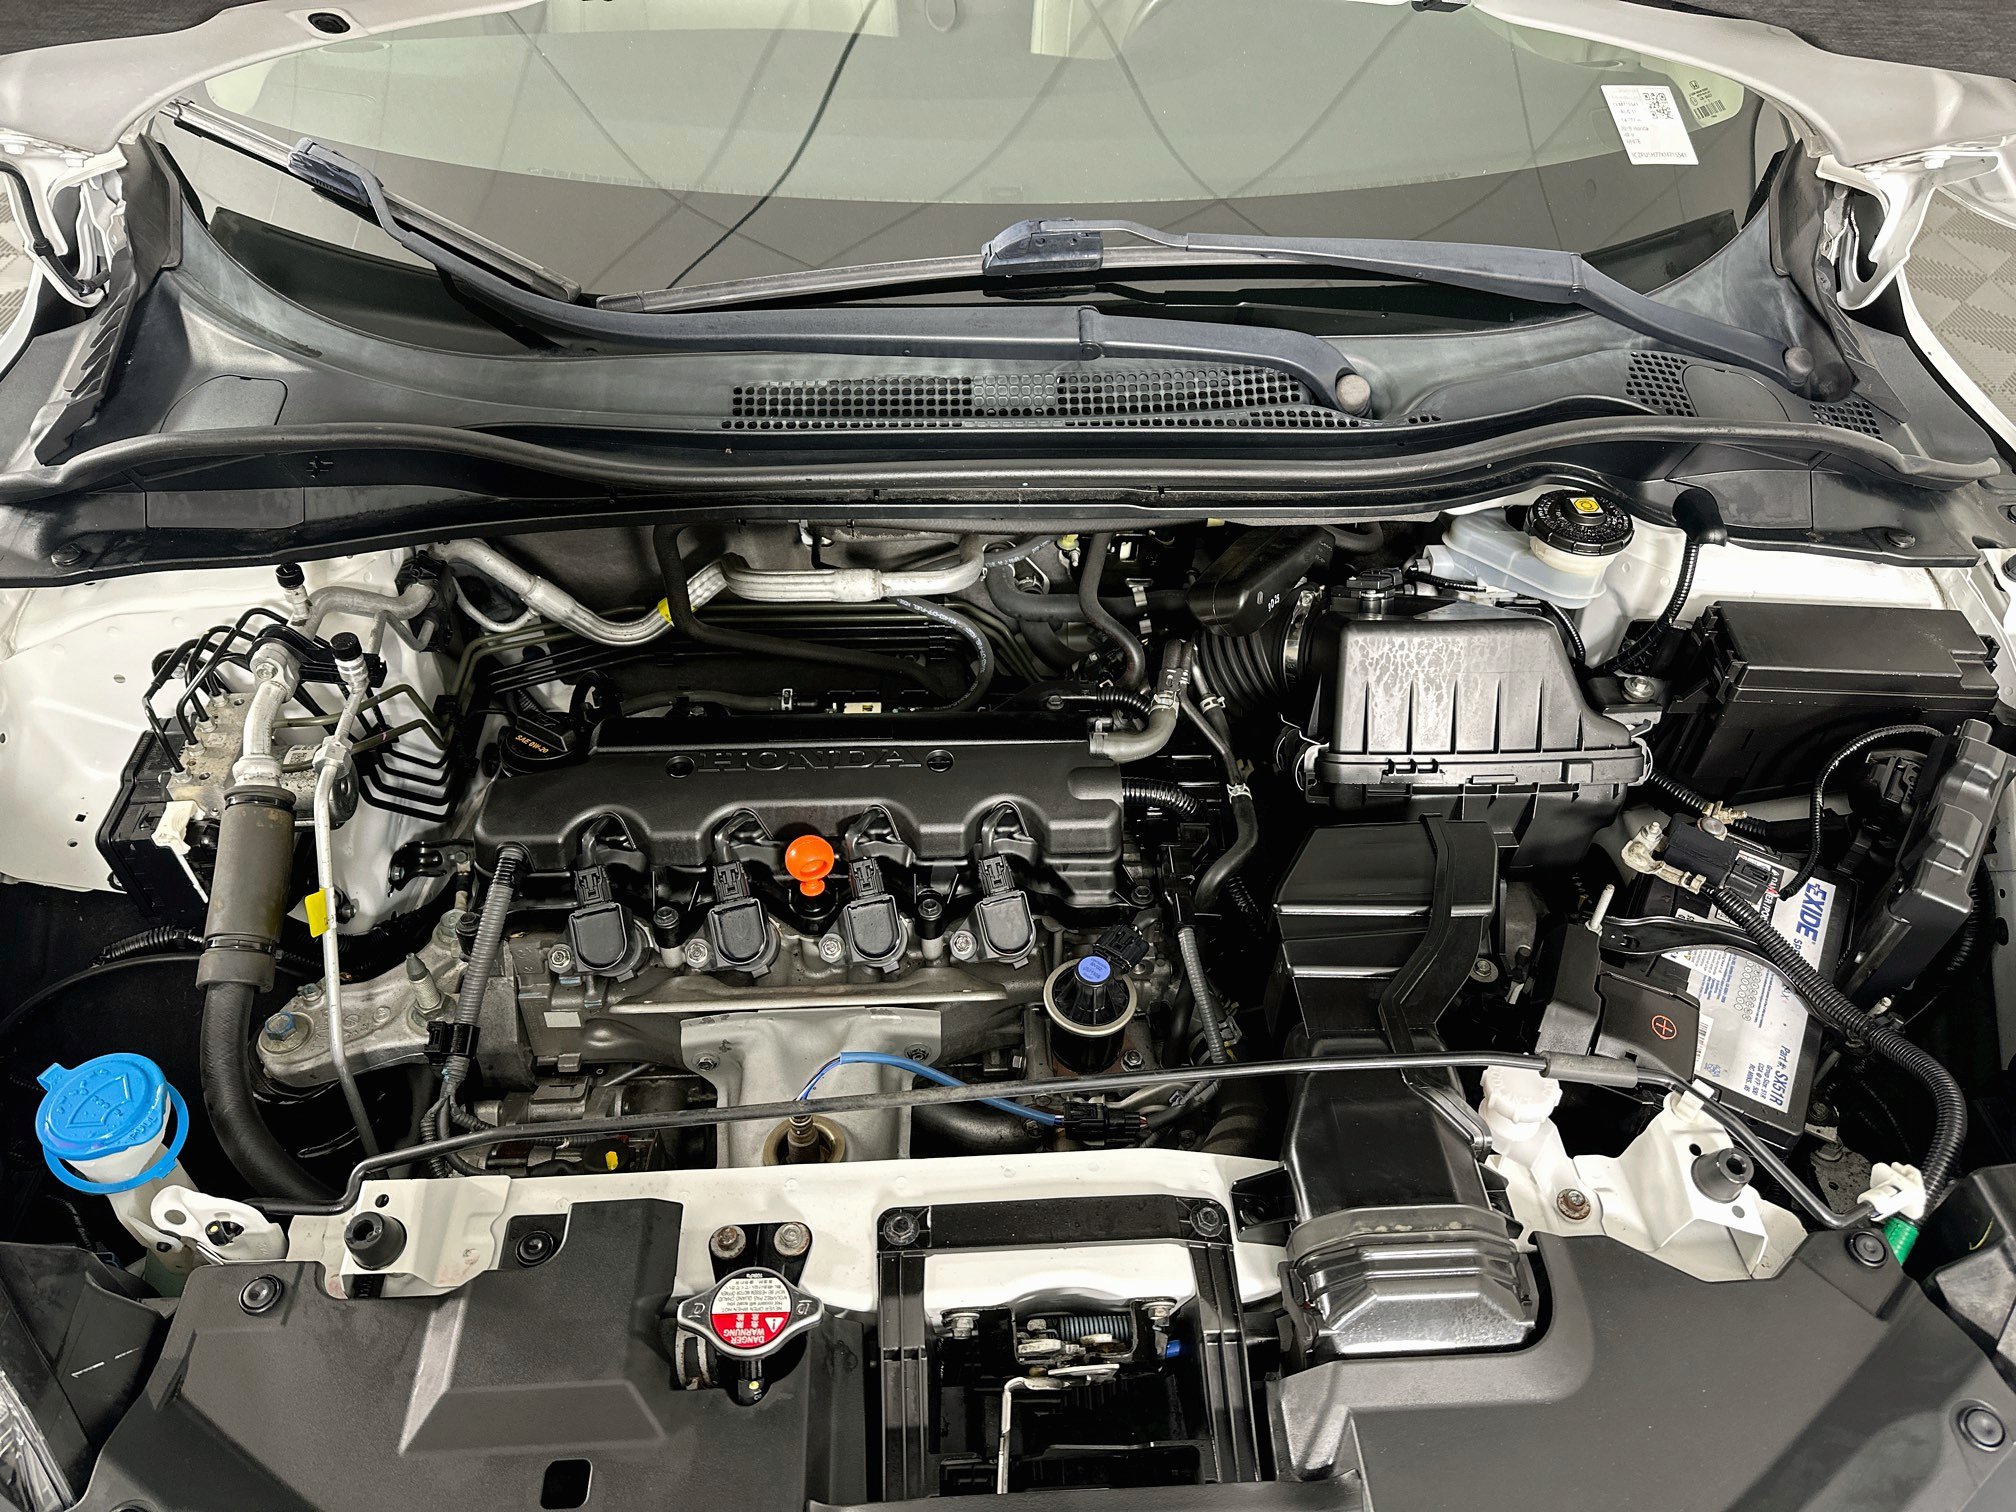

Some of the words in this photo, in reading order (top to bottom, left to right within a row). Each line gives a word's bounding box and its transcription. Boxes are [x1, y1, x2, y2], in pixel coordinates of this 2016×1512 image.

[515, 734, 531, 745] SAE
[698, 748, 922, 772] HONDA
[1796, 883, 1827, 942] EXIDE
[1779, 1045, 1790, 1062] Part
[1769, 1070, 1789, 1106] SX51R
[128, 1116, 159, 1140] PULL
[723, 1328, 765, 1336] WARNUNG
[730, 1336, 765, 1344] DANGER
